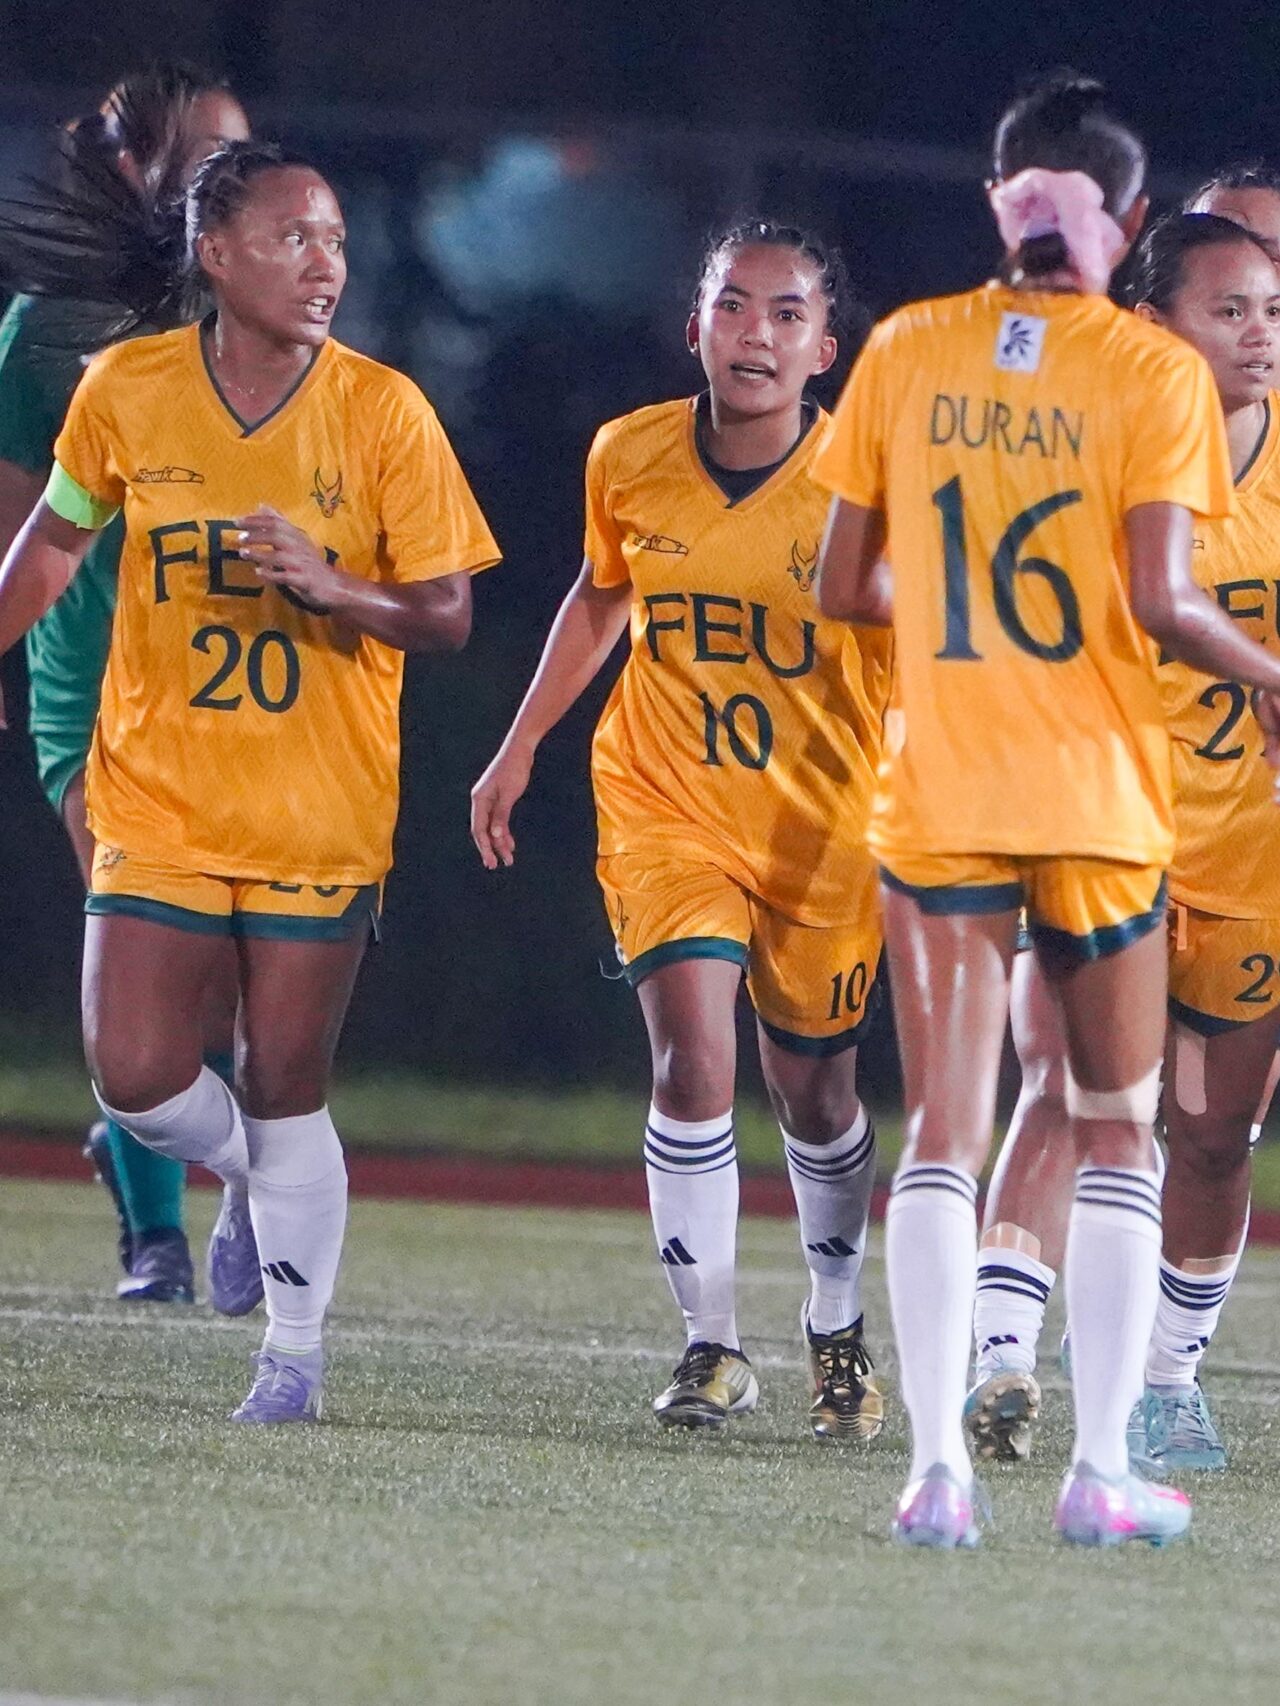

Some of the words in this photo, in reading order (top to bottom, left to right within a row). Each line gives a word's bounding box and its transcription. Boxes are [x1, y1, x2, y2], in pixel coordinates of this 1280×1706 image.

[932, 394, 1084, 461] DURAN
[932, 473, 1084, 663] 16
[189, 624, 301, 713] 20
[644, 592, 817, 679] FEU
[698, 691, 775, 771] 10
[1194, 681, 1266, 762] 2
[825, 961, 867, 1021] 10
